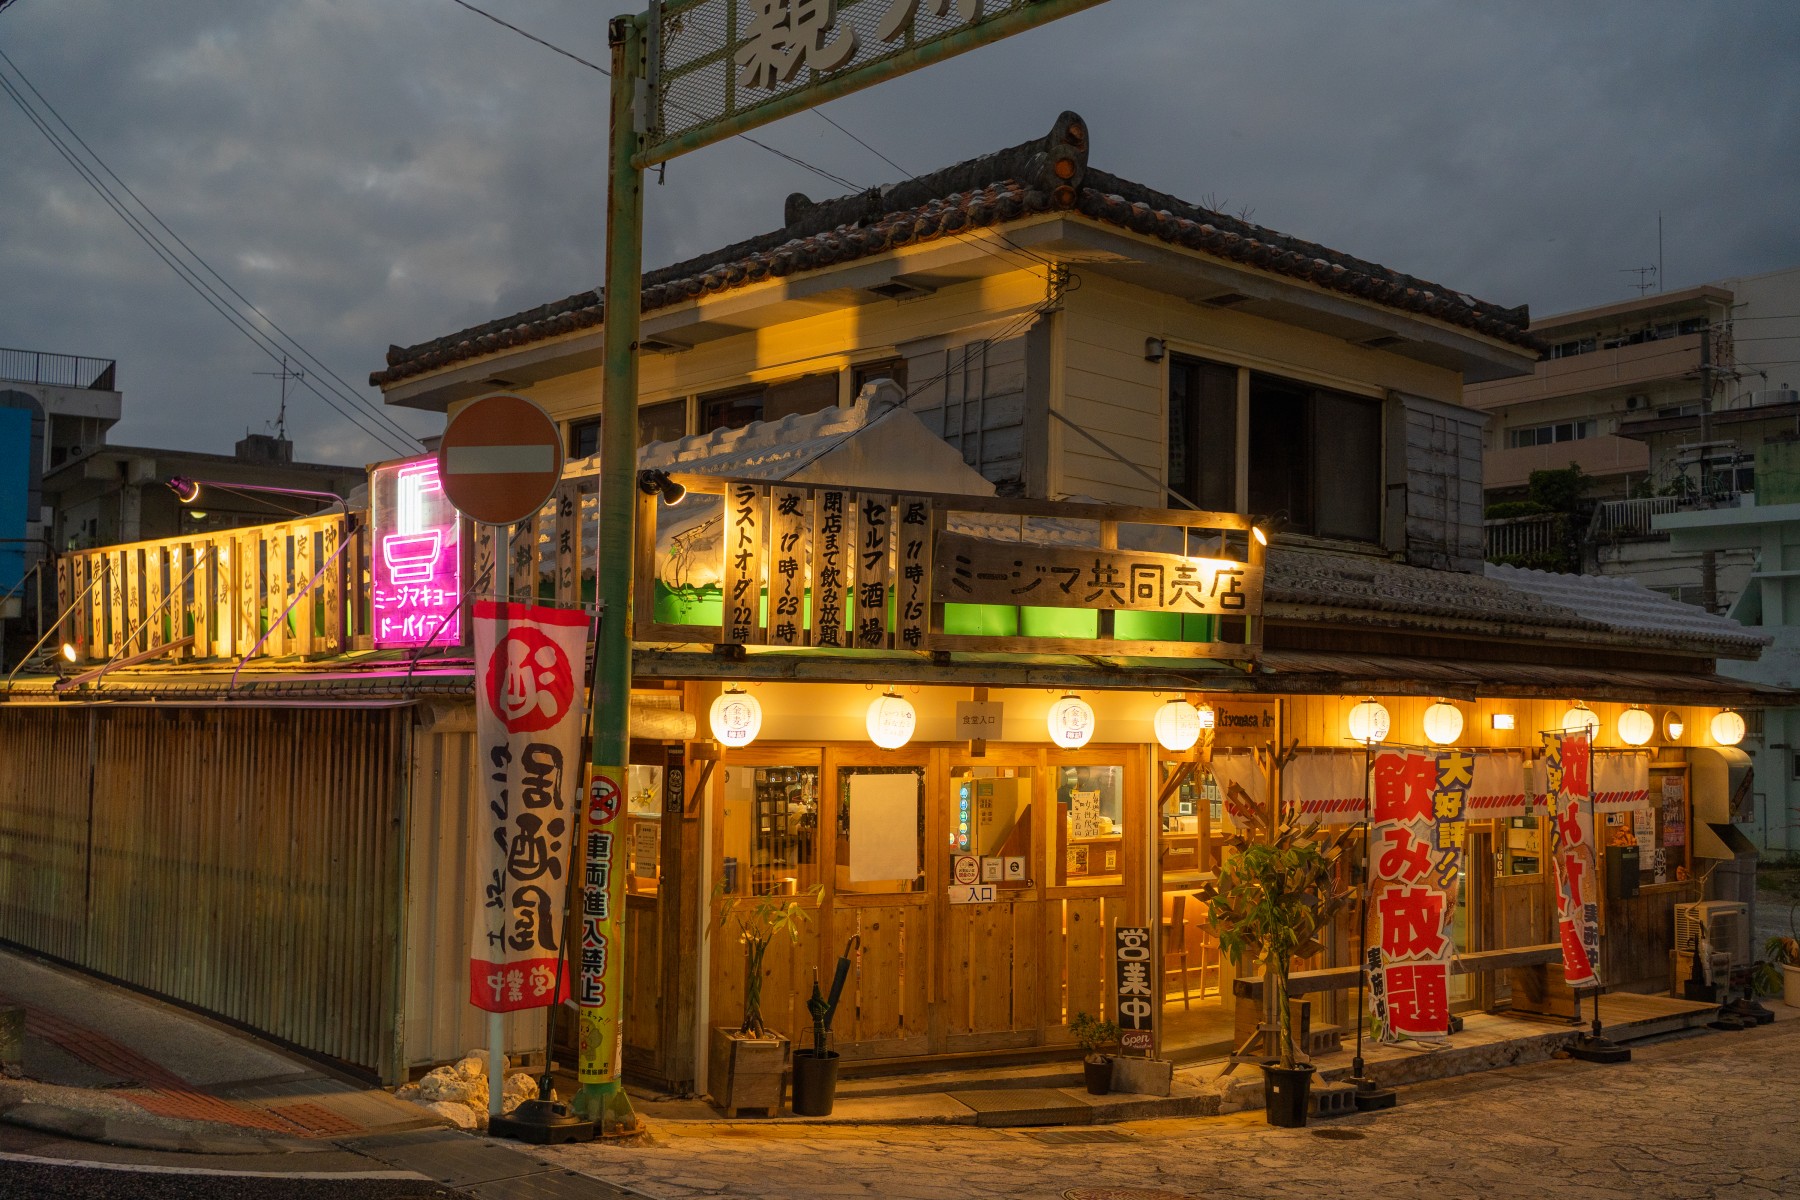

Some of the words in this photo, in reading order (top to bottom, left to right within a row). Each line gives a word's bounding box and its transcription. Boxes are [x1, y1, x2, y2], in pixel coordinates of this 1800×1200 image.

[296, 534, 309, 598] 定食
[818, 491, 844, 647] 閉店まで飲み放題
[952, 555, 1245, 609] ミージマ共同売店
[381, 614, 450, 639] ドーバイテン
[962, 715, 995, 725] 食堂入口
[581, 831, 610, 1004] 車両進入禁止
[968, 887, 992, 901] 入口
[1374, 752, 1449, 1038] 飲み放題
[1117, 927, 1151, 1030] 営業中
[1121, 1033, 1150, 1047] Open
